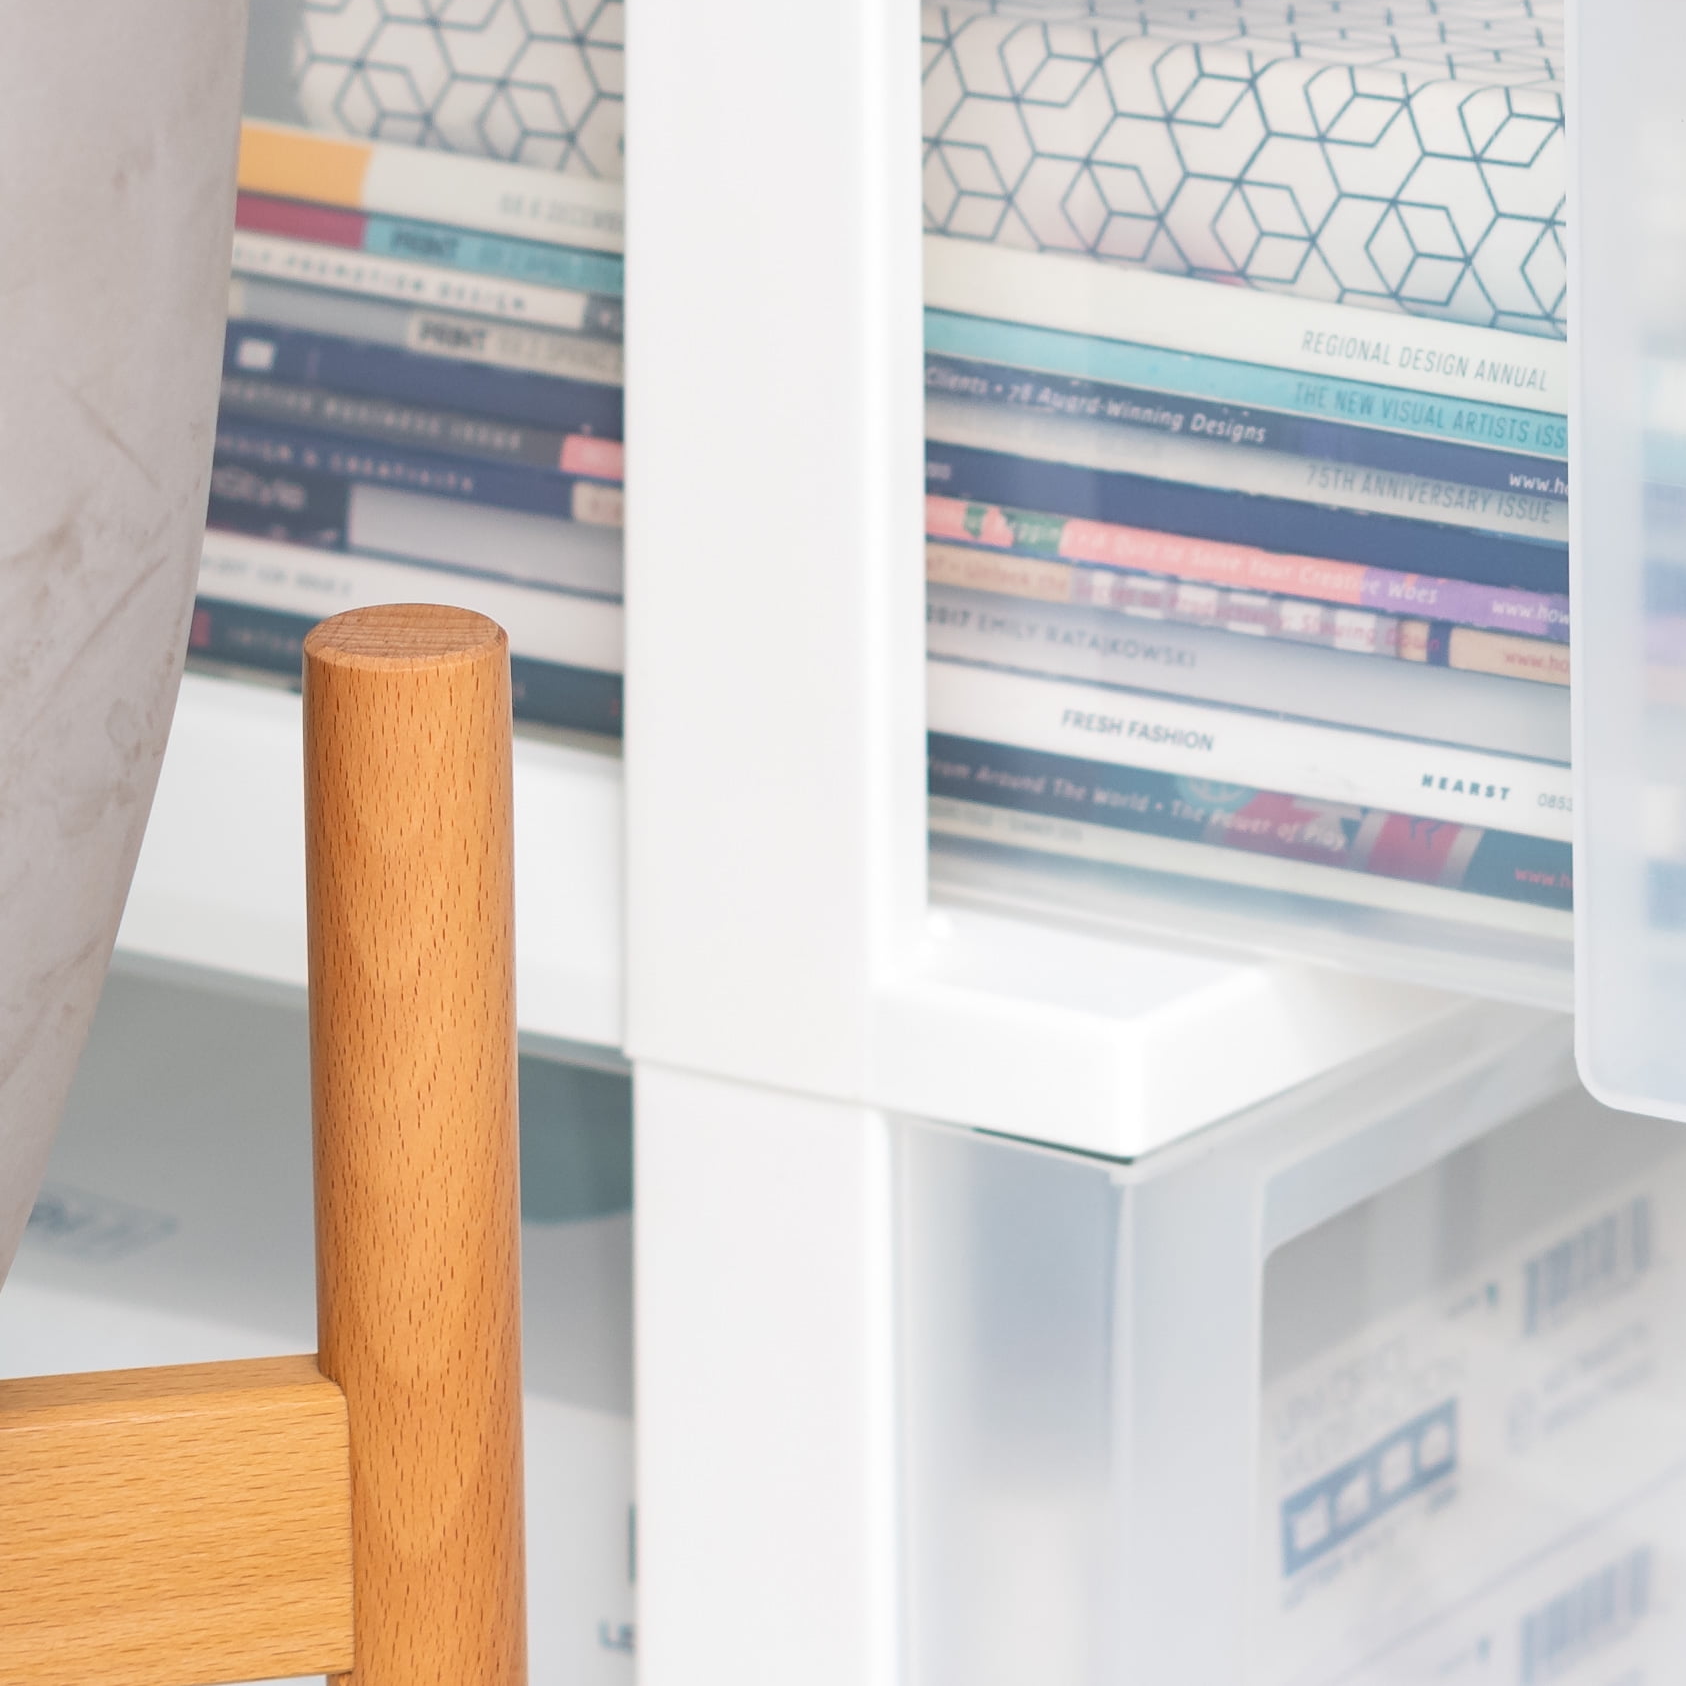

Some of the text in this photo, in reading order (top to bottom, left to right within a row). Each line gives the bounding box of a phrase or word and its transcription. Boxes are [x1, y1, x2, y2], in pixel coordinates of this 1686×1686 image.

[1301, 330, 1549, 393] REGIONAL DESIGN ANNUAL
[1190, 413, 1268, 444] Designs
[1294, 381, 1329, 408] THE
[1335, 389, 1375, 417] NEW
[1382, 399, 1445, 431] VISUAL
[1453, 411, 1533, 445] ARTISTS
[1306, 464, 1554, 526] 75TH ANNIVERSARY ISSUE
[1299, 564, 1380, 596] Creative
[1387, 578, 1439, 605] Woes
[977, 614, 1039, 642] EMILY
[1045, 625, 1198, 668] RATAJKOWSKI
[1062, 708, 1215, 752] FRESH FASHION
[1421, 773, 1512, 802] HEARST
